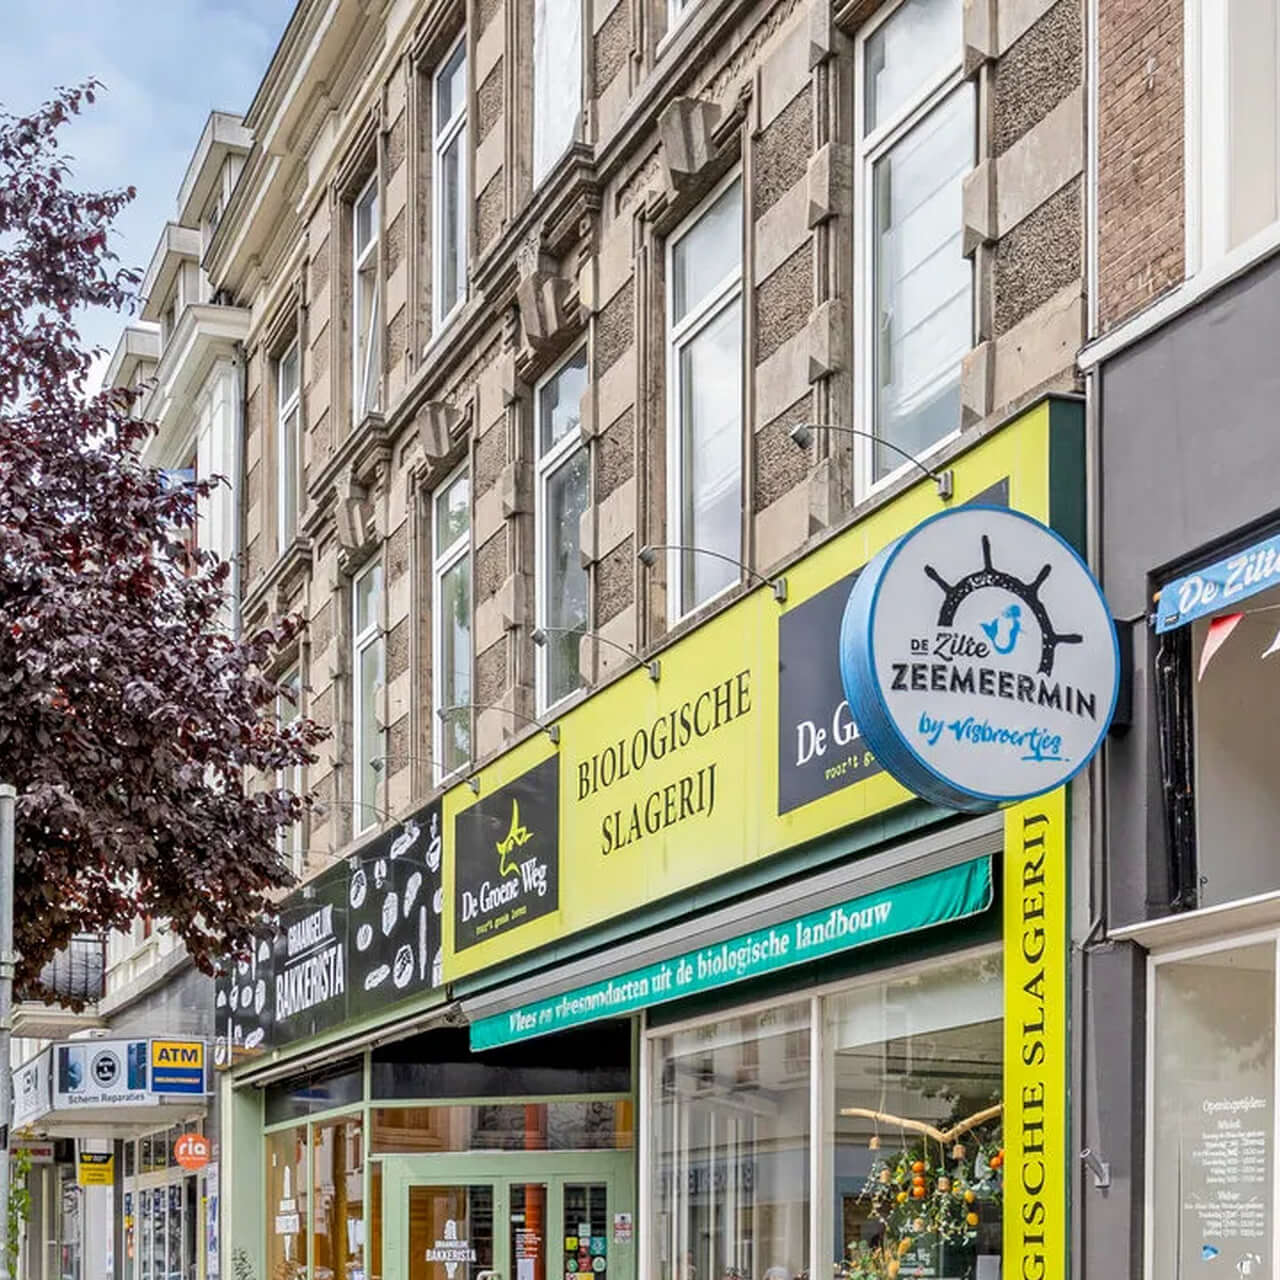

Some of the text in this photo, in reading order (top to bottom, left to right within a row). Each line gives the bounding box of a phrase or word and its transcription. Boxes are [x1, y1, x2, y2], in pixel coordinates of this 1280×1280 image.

[1178, 575, 1219, 612] De
[911, 631, 990, 661] DE Zilte
[891, 663, 1097, 722] ZEEMEERMIN
[577, 668, 752, 801] BIOLOGISCHE
[796, 721, 827, 767] De
[918, 711, 944, 746] by
[601, 763, 717, 856] SLAGERIJ
[462, 857, 547, 922] De Groene Weg
[1022, 813, 1050, 1067] SLAGERIJ
[276, 943, 344, 1021] BAKKERISTA
[509, 901, 892, 1034] Vlees en vleesproducten uit de biologische landbouw
[158, 1048, 197, 1062] ATM
[101, 1093, 144, 1104] Reparaties
[179, 1138, 206, 1155] ria
